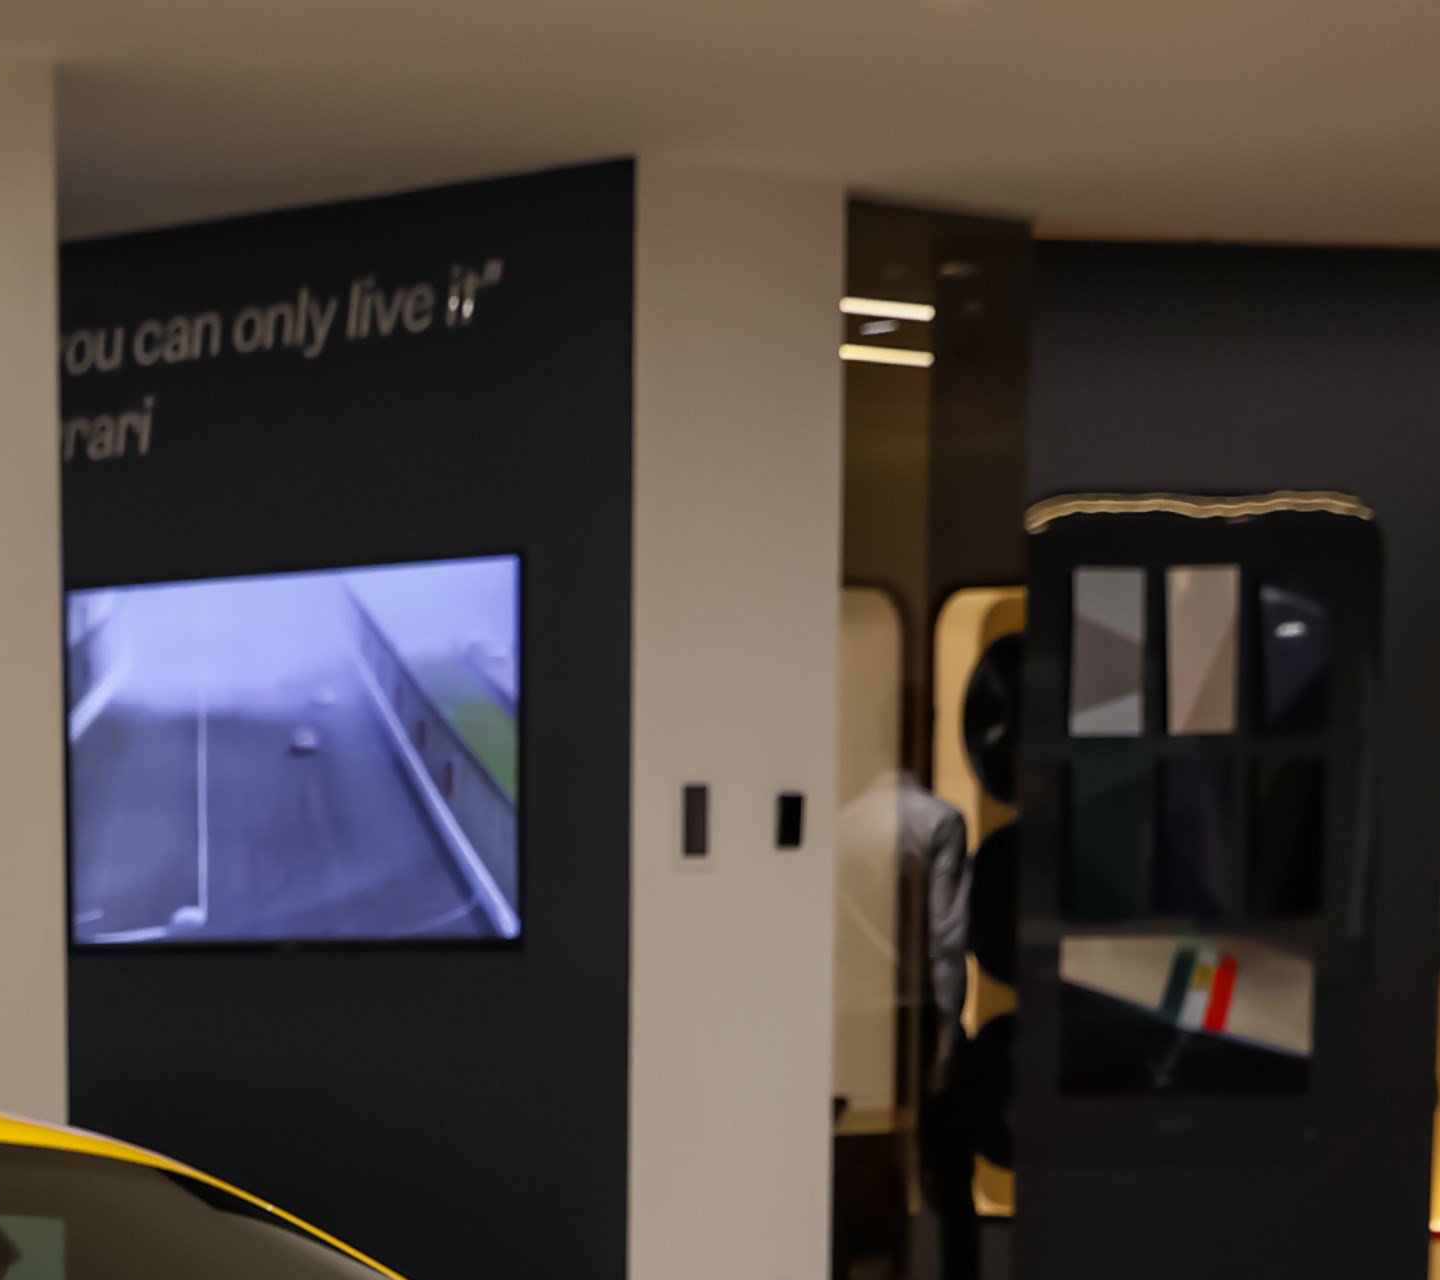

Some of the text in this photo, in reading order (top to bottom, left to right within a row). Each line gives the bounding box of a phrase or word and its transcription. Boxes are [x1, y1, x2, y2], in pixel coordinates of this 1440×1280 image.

[60, 326, 124, 376] ou
[132, 311, 221, 366] can
[232, 286, 338, 359] only
[346, 275, 434, 341] live
[61, 394, 155, 462] rari
